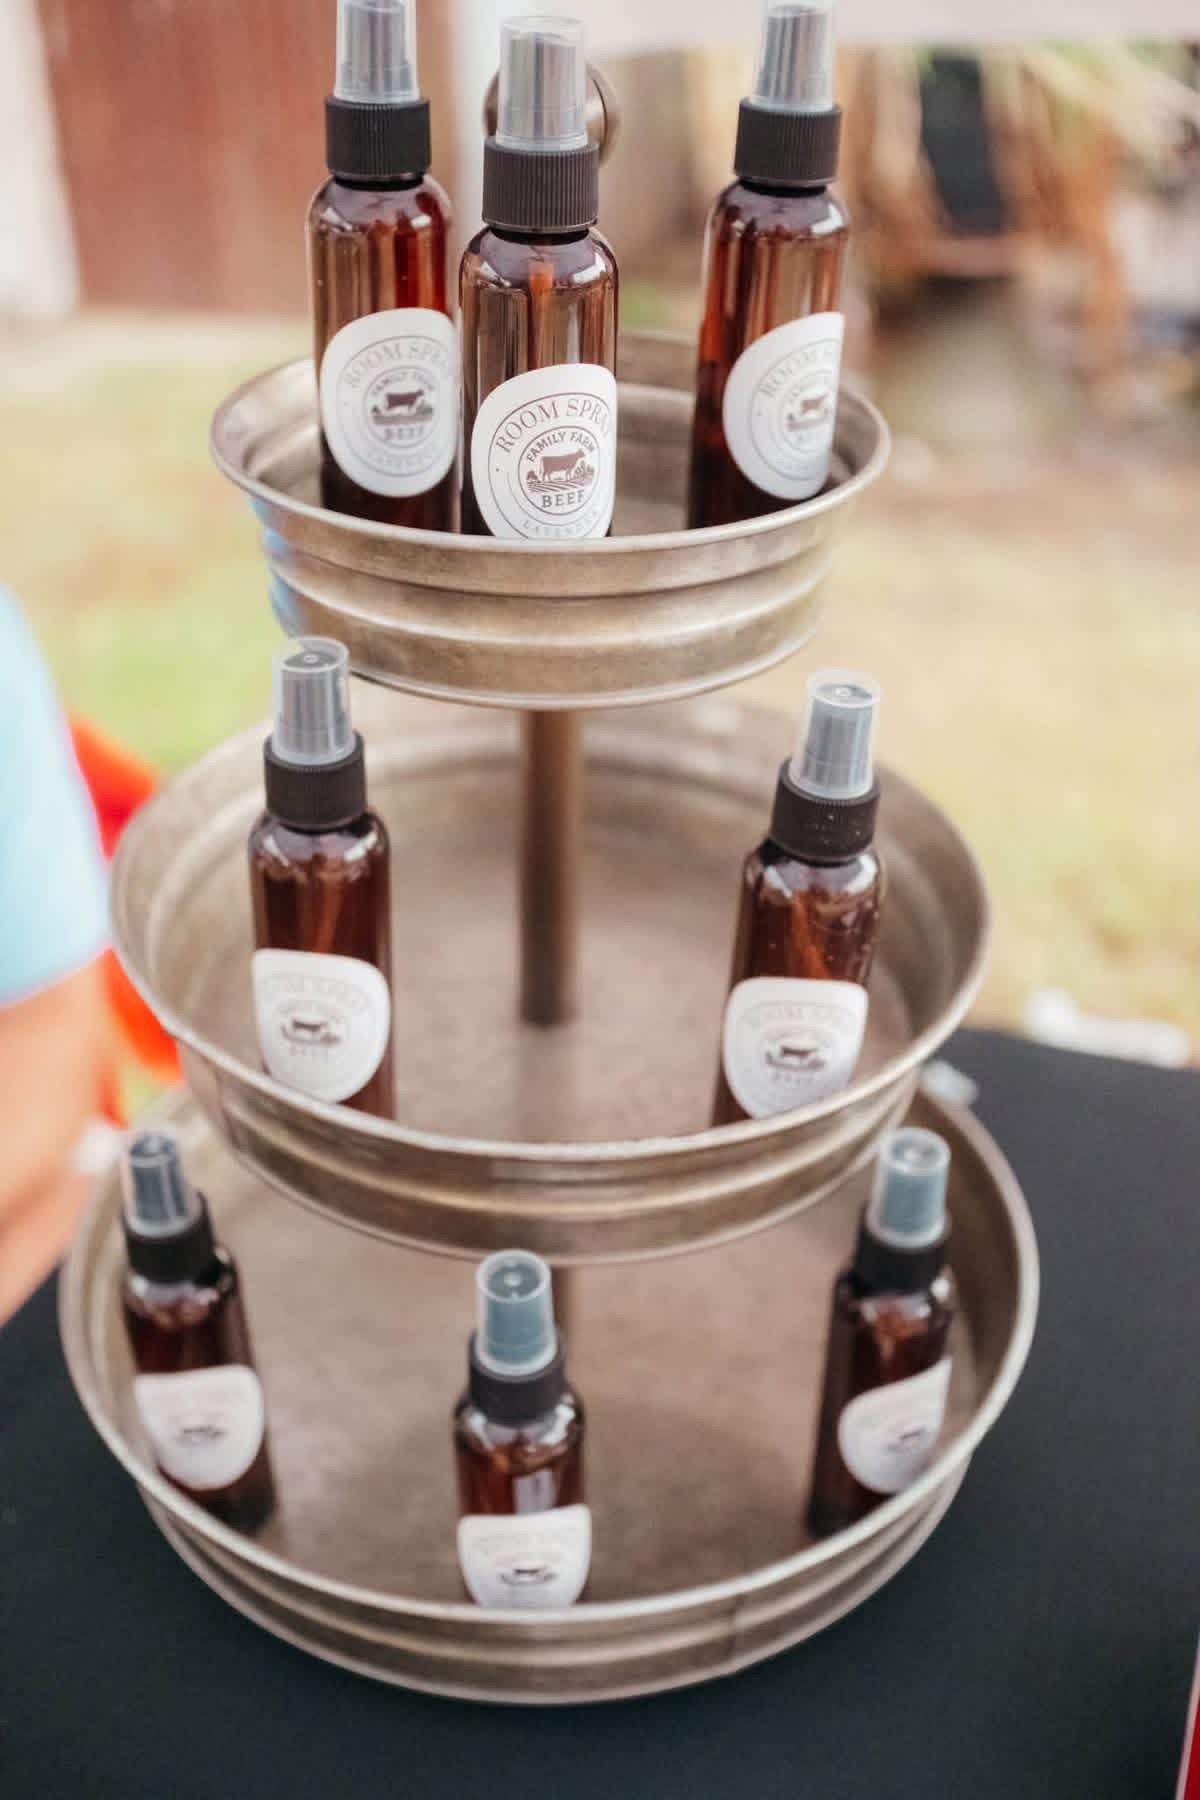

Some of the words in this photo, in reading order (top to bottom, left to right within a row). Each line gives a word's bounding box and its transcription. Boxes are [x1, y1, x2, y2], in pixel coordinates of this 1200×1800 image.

[344, 343, 402, 388] ROOM
[495, 401, 560, 454] ROOM
[526, 431, 567, 463] FAMILY
[570, 431, 597, 453] FARM
[541, 489, 586, 508] BEEF
